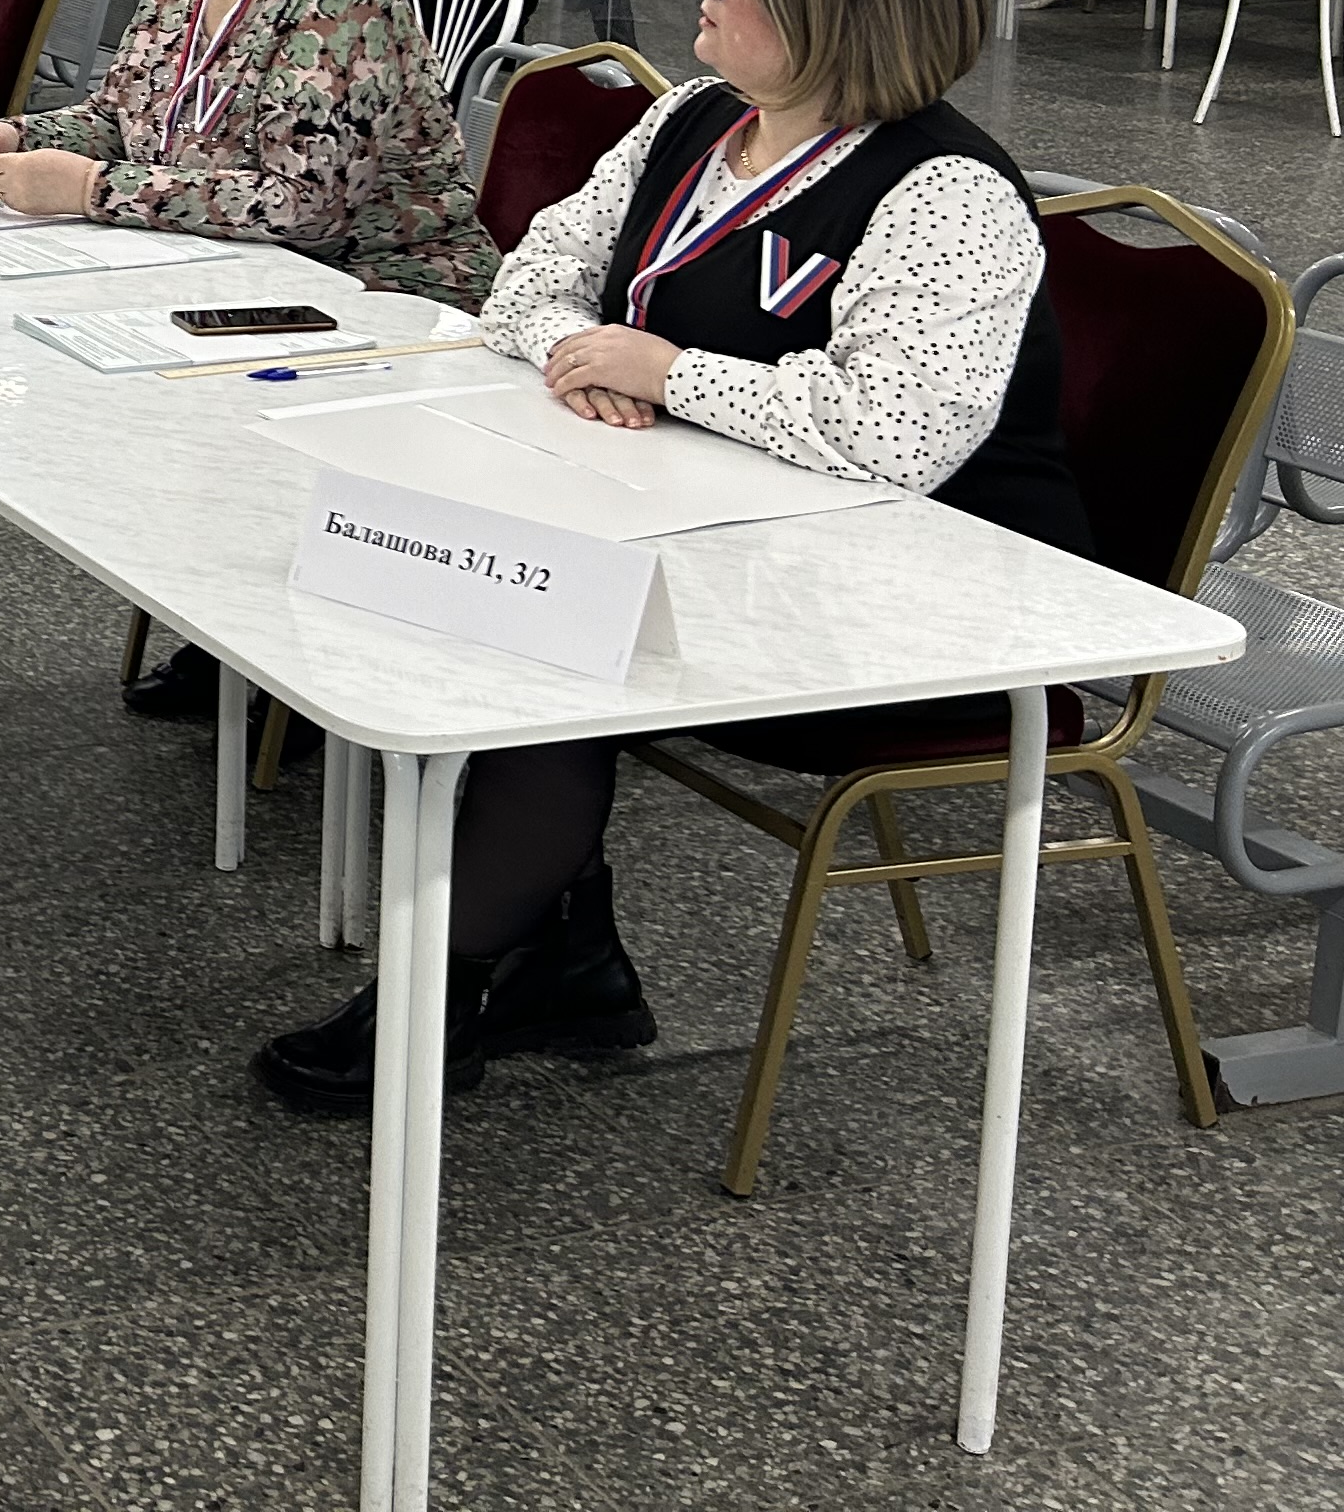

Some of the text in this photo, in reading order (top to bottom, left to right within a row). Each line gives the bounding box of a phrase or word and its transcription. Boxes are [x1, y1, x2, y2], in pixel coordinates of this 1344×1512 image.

[323, 509, 551, 592] Балашова 3/1, 3/2
